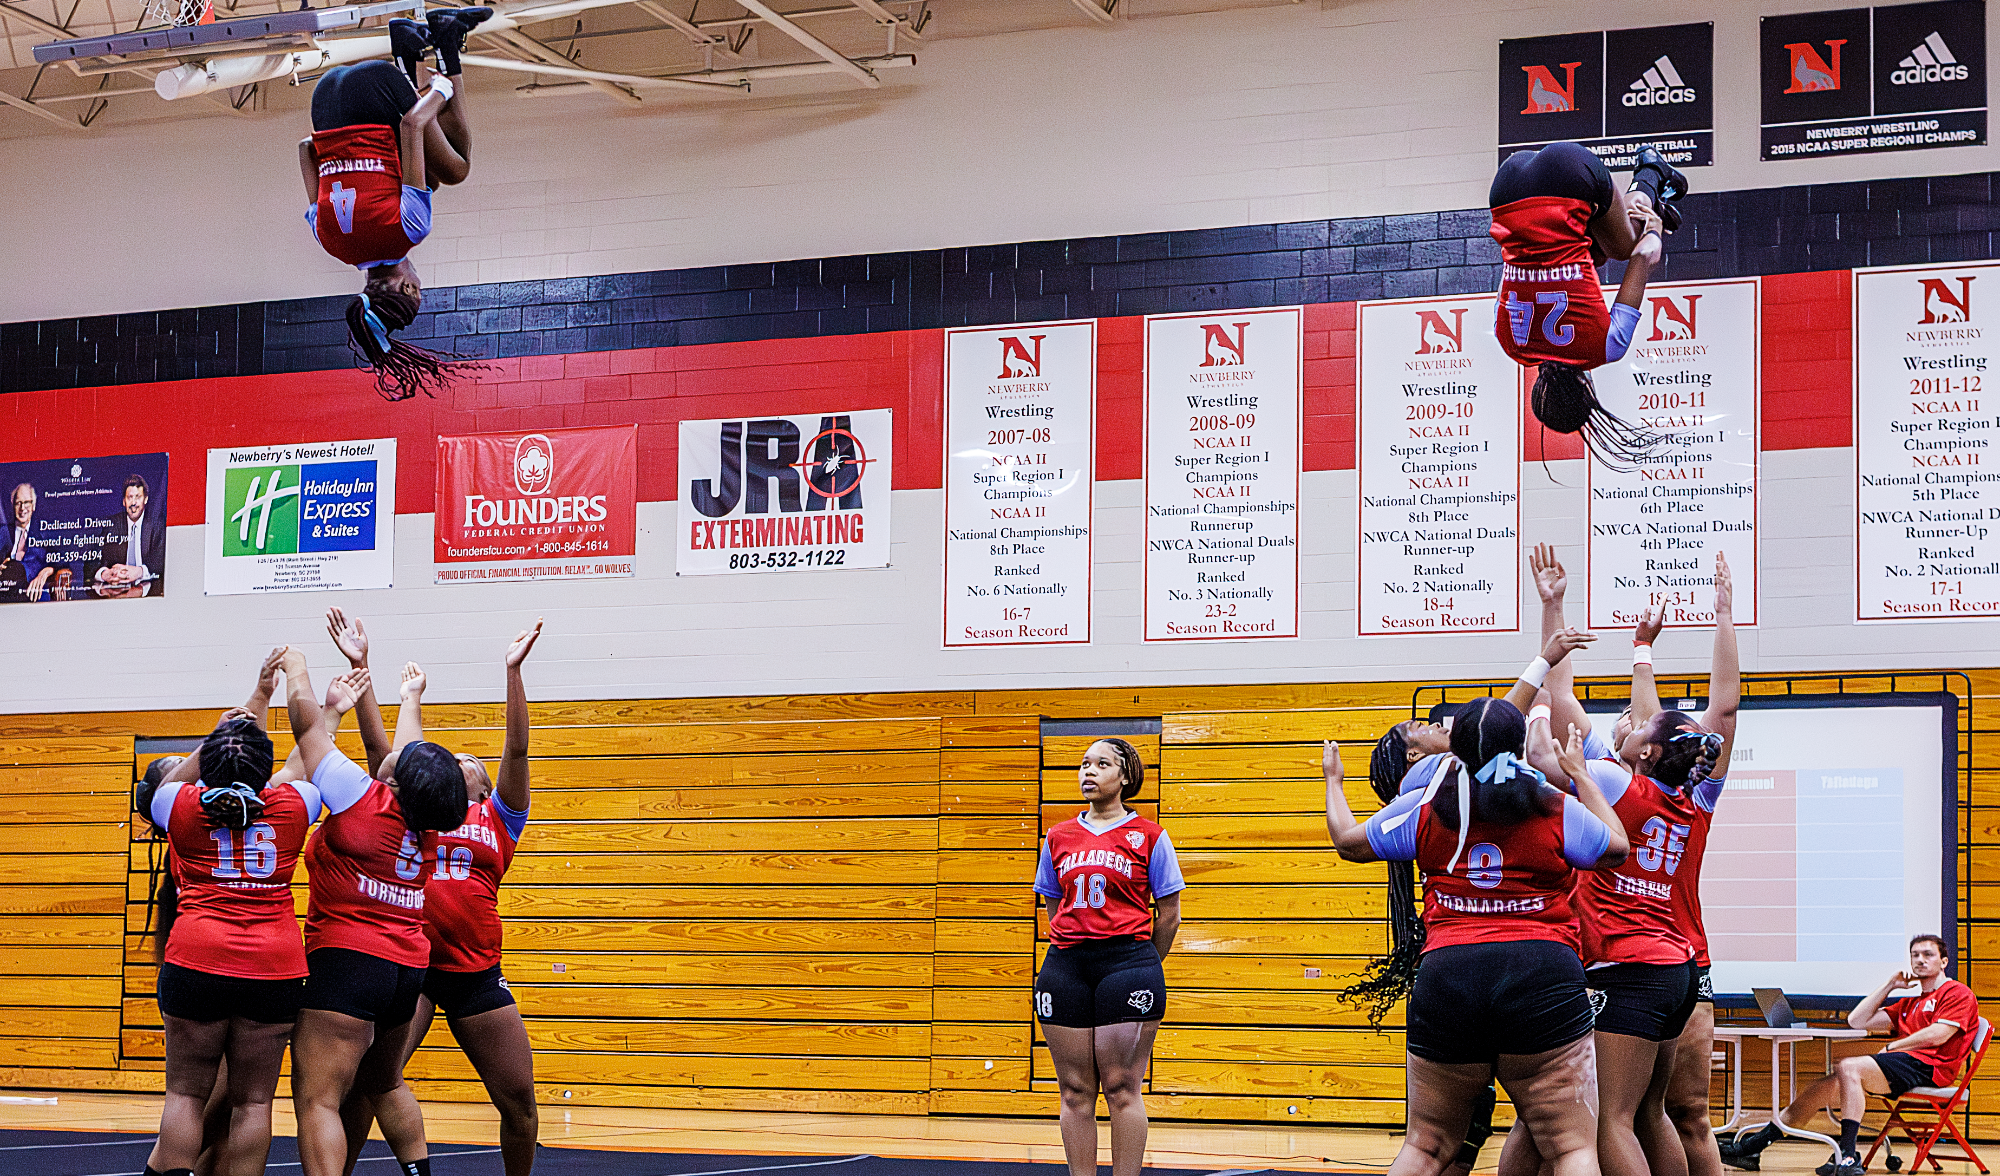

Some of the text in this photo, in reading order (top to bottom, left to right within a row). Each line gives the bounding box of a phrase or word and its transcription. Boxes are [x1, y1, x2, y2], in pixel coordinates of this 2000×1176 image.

[1891, 63, 1968, 85] adidas
[1622, 87, 1696, 107] adidas
[1806, 121, 1939, 139] NEWBERRY WRESTLING
[1771, 130, 1976, 154] 2015 NCAA SUPER REGION CHAMPS
[330, 181, 356, 234] 4
[1505, 291, 1575, 347] 24
[1906, 328, 1983, 342] NEWBERRY
[1636, 345, 1709, 358] NEWBERRY
[1405, 358, 1474, 371] NEWBERRY
[1903, 354, 1987, 372] Wrestling
[1189, 371, 1256, 383] NEWBERRY
[1633, 371, 1712, 387] Wrestling
[988, 383, 1051, 394] NEWBERRY
[1402, 382, 1477, 398] Wrestling
[1910, 376, 1981, 395] 2011-12
[1187, 394, 1258, 409] Wrestling
[1639, 391, 1705, 410] 2010-11
[1912, 401, 1960, 414] NCAA
[985, 404, 1054, 420] Wrestling
[1406, 402, 1473, 420] 2009-10
[1189, 414, 1255, 431] 2008-09
[1641, 416, 1687, 428] NCAA
[1891, 418, 1989, 435] Super Region
[988, 428, 1051, 445] 2007-08
[1409, 426, 1453, 438] NCAA
[1665, 431, 1714, 447] Region
[1194, 436, 1250, 449] NCAA II
[1390, 441, 1478, 459] Super Region
[1904, 437, 1988, 452] Champions
[230, 444, 374, 463] Newberry's Newest Hotel!
[1175, 453, 1259, 468] Super Region
[1633, 451, 1712, 466] Champions
[1913, 454, 1961, 467] NCAA
[691, 416, 863, 517] JRA
[1402, 461, 1477, 475] Champions
[1013, 470, 1054, 484] Region
[1186, 470, 1258, 485] Champions
[1641, 468, 1687, 481] NCAA
[1862, 474, 1920, 486] National
[304, 478, 374, 497] Holiday Inn
[1409, 477, 1453, 489] NCAA
[984, 488, 1052, 502] Champions
[1193, 486, 1234, 498] NCAA
[1593, 483, 1752, 499] National Championships
[1913, 488, 1980, 501] 5th Place
[1364, 491, 1516, 507] National Championships
[304, 500, 370, 524] Express
[464, 495, 607, 527] FOUNDERS
[991, 507, 1046, 519] NCAA II
[1150, 500, 1295, 516] National Championships
[1640, 502, 1703, 514] 6th Place
[40, 517, 114, 531] Dedicated. Driven.
[1409, 511, 1469, 523] 8th Place
[1862, 509, 1983, 524] NWCA National
[312, 525, 359, 537] & Suites
[464, 524, 605, 537] FEDERAL CREDIT UNION
[690, 513, 864, 551] EXTERMINATING
[950, 525, 1087, 540] National Championships
[1191, 521, 1253, 533] Runnerup
[1593, 520, 1752, 536] NWCA National Duals
[1906, 525, 1987, 540] Runner-Up
[29, 533, 118, 547] Devoted to fighting for
[1363, 527, 1515, 543] NWCA National Duals
[448, 541, 608, 557] foundersfcu.com 1-800-845-1614
[990, 544, 1045, 555] 8th Place
[1150, 536, 1294, 551] NWCA National Duals
[1403, 545, 1474, 557] Runner-up
[1640, 538, 1703, 550] 4th Place
[46, 550, 102, 563] 803-359-6194
[729, 550, 844, 569] 803-532-1122
[1188, 553, 1255, 565] Runner-up
[1919, 546, 1974, 559] Ranked
[994, 564, 1040, 576] Ranked
[1414, 563, 1463, 576] Ranked
[1646, 558, 1698, 571] Ranked
[1886, 565, 1912, 577] No.
[438, 570, 458, 580] PROUD
[460, 569, 486, 579] OFFICIAL
[1197, 571, 1245, 583] Ranked
[967, 583, 1067, 596] No. Nationally
[1383, 580, 1493, 594] No. Nationally
[1614, 577, 1639, 588] No.
[1931, 581, 1963, 595] 17-1
[1168, 587, 1273, 601] No. Nationally
[1206, 604, 1236, 617] 23-2
[1423, 597, 1454, 611] 18-4
[1883, 600, 1941, 613] Season
[1003, 608, 1030, 620] 16-7
[1382, 613, 1495, 628] Season Record
[965, 624, 1068, 638] Season Record
[1167, 619, 1275, 634] Season Record
[210, 823, 278, 879] 16
[1636, 816, 1691, 876] 35
[432, 845, 473, 880] 10
[1058, 850, 1132, 879] TALLADEGA
[1466, 842, 1503, 889] 8
[1073, 874, 1106, 908] 18
[1035, 991, 1052, 1017] 18
